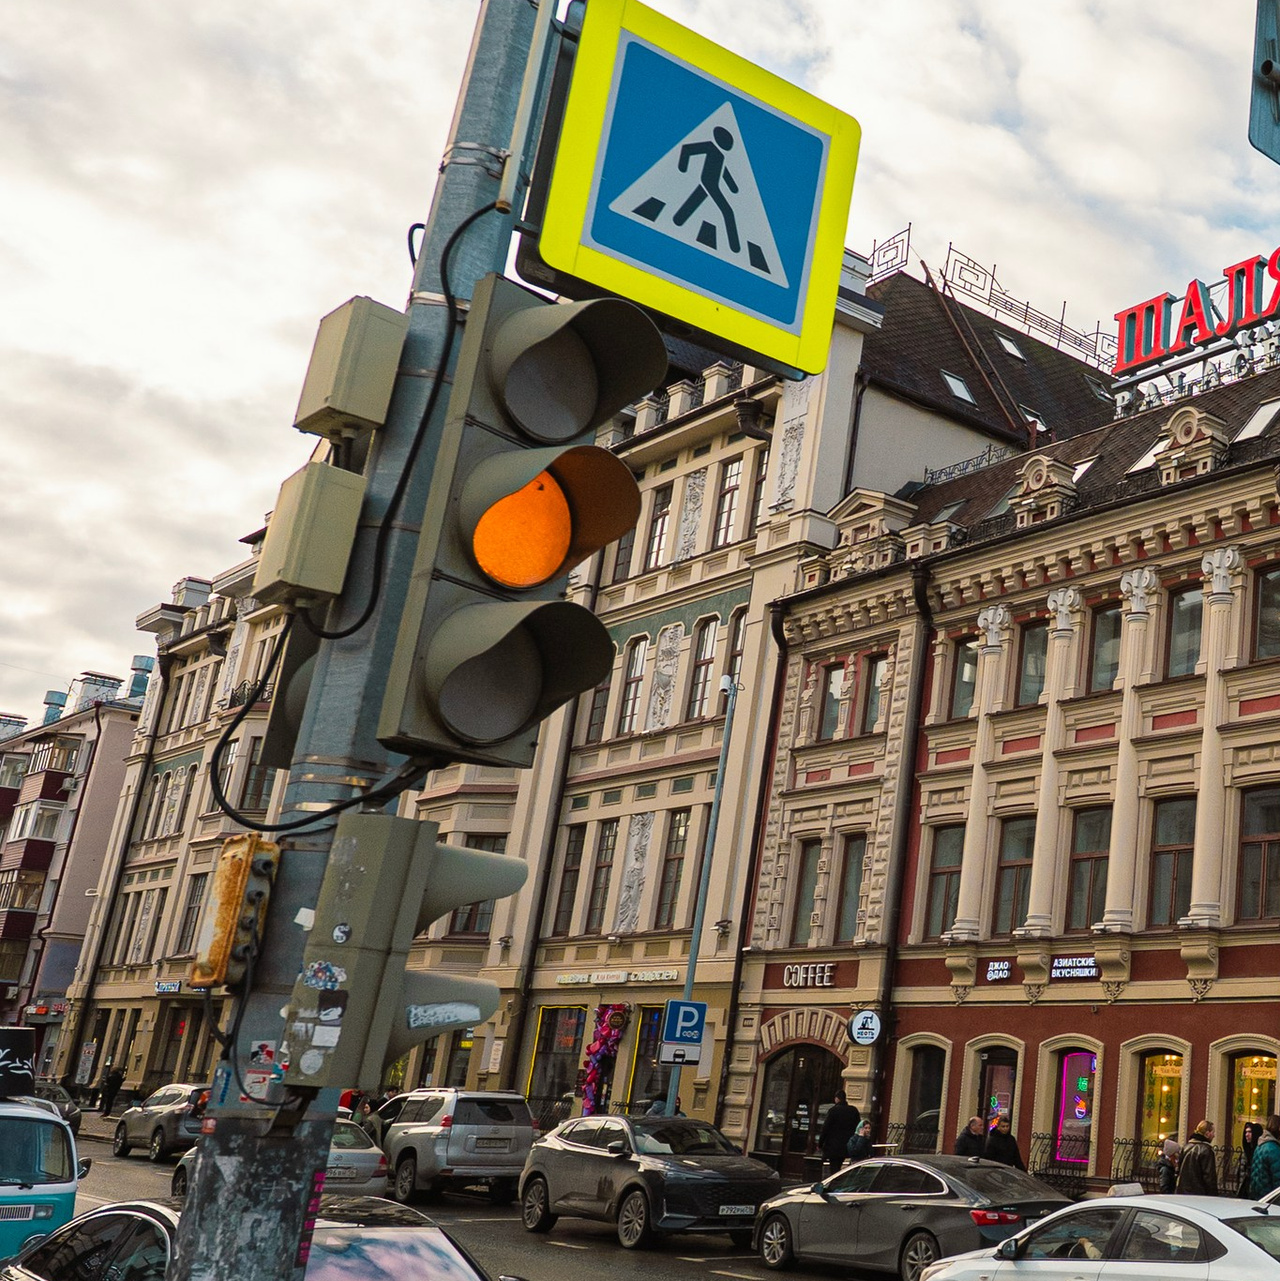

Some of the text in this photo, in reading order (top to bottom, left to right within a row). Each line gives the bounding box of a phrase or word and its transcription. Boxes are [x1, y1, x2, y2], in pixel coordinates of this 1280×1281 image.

[988, 961, 1010, 971] ДЖАО
[1053, 958, 1096, 967] АЗИАТСКИЕ
[783, 963, 835, 987] COFFEE
[1051, 968, 1096, 978] ВКУСНЯШКИ
[675, 1006, 699, 1038] P
